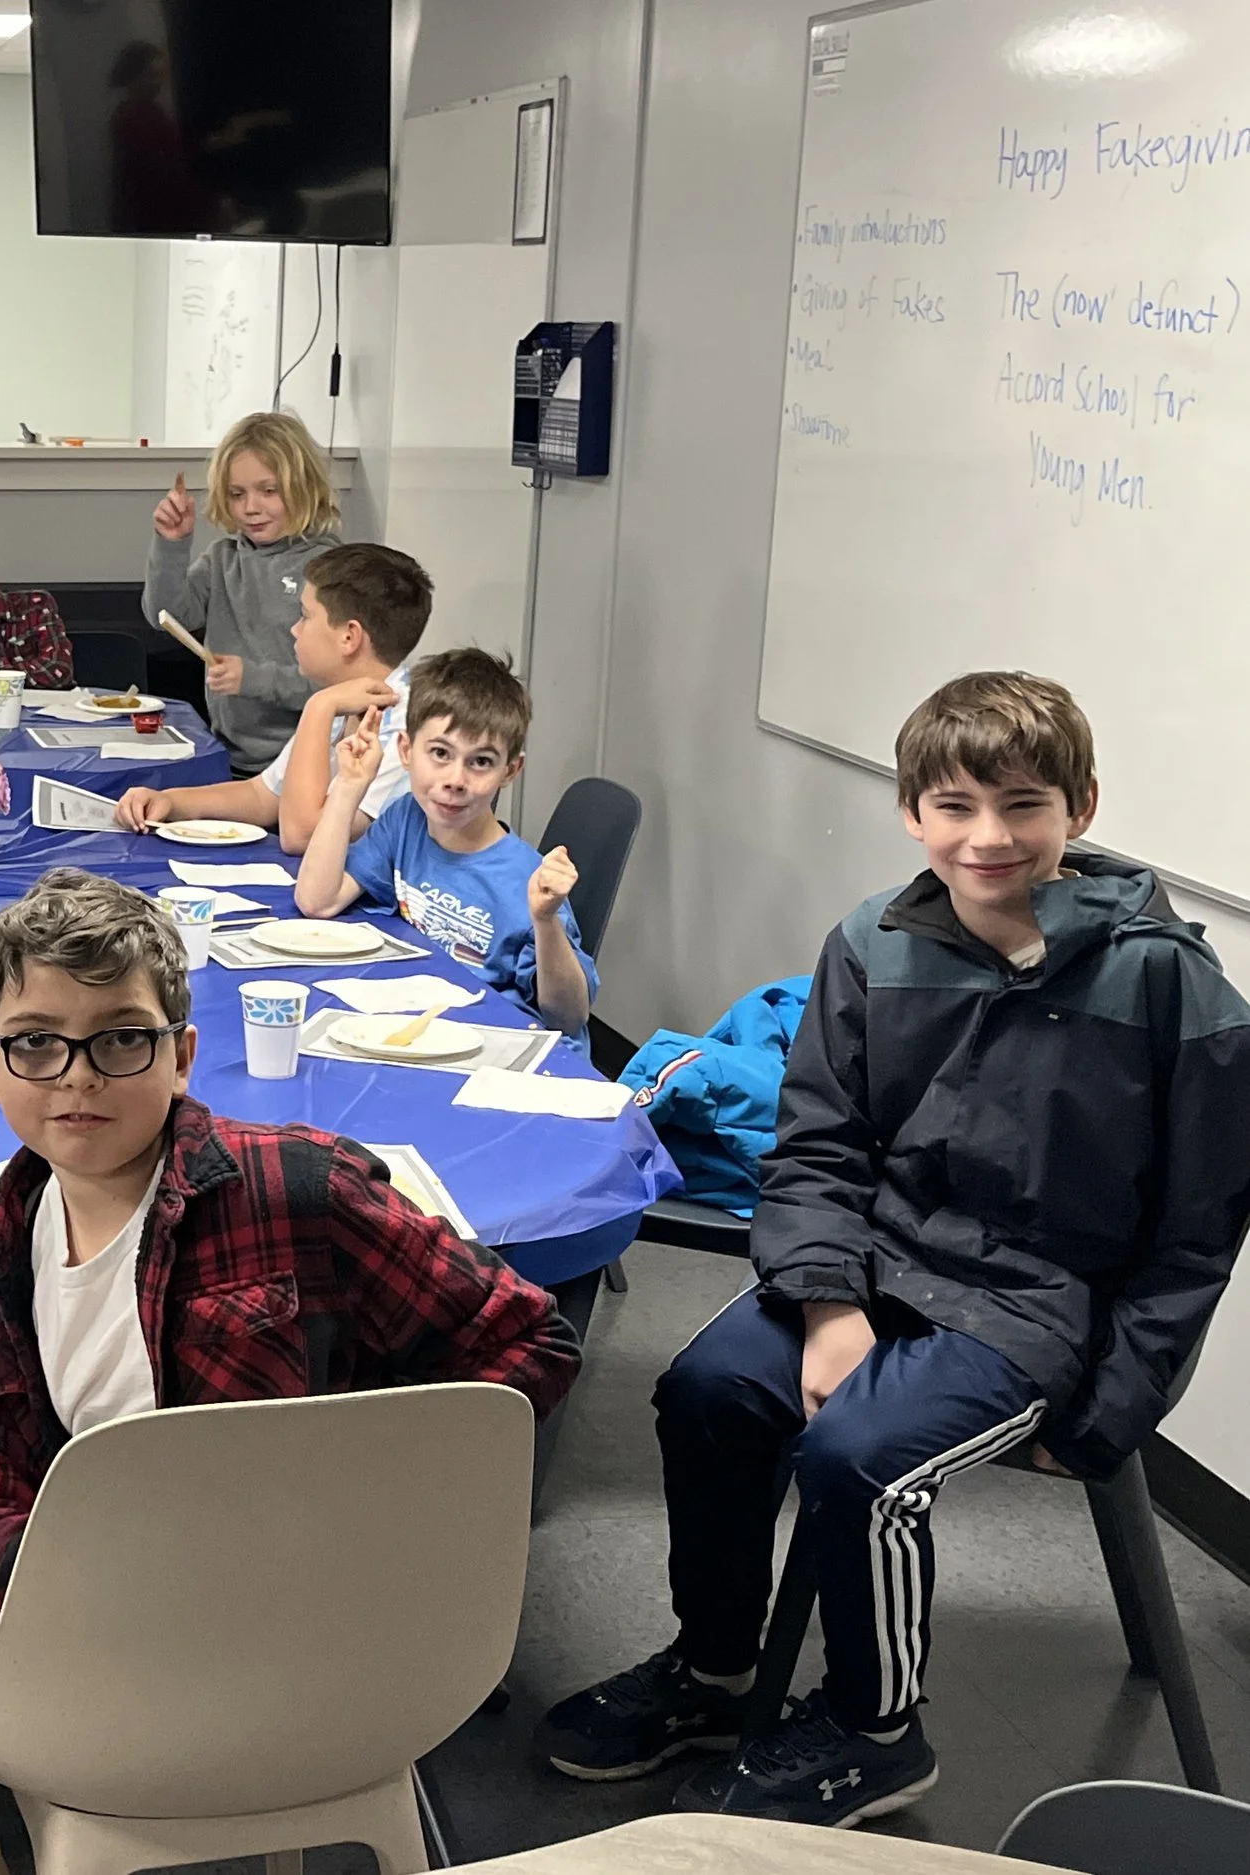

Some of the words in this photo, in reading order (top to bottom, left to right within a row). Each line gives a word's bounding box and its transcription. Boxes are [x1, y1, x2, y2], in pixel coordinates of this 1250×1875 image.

[998, 126, 1067, 200] Happy
[858, 275, 879, 318] of
[891, 277, 946, 323] Fakes
[996, 271, 1040, 322] The
[995, 352, 1066, 404] Accord
[1073, 365, 1139, 429] School
[1154, 373, 1196, 424] for
[1030, 430, 1086, 527] Young
